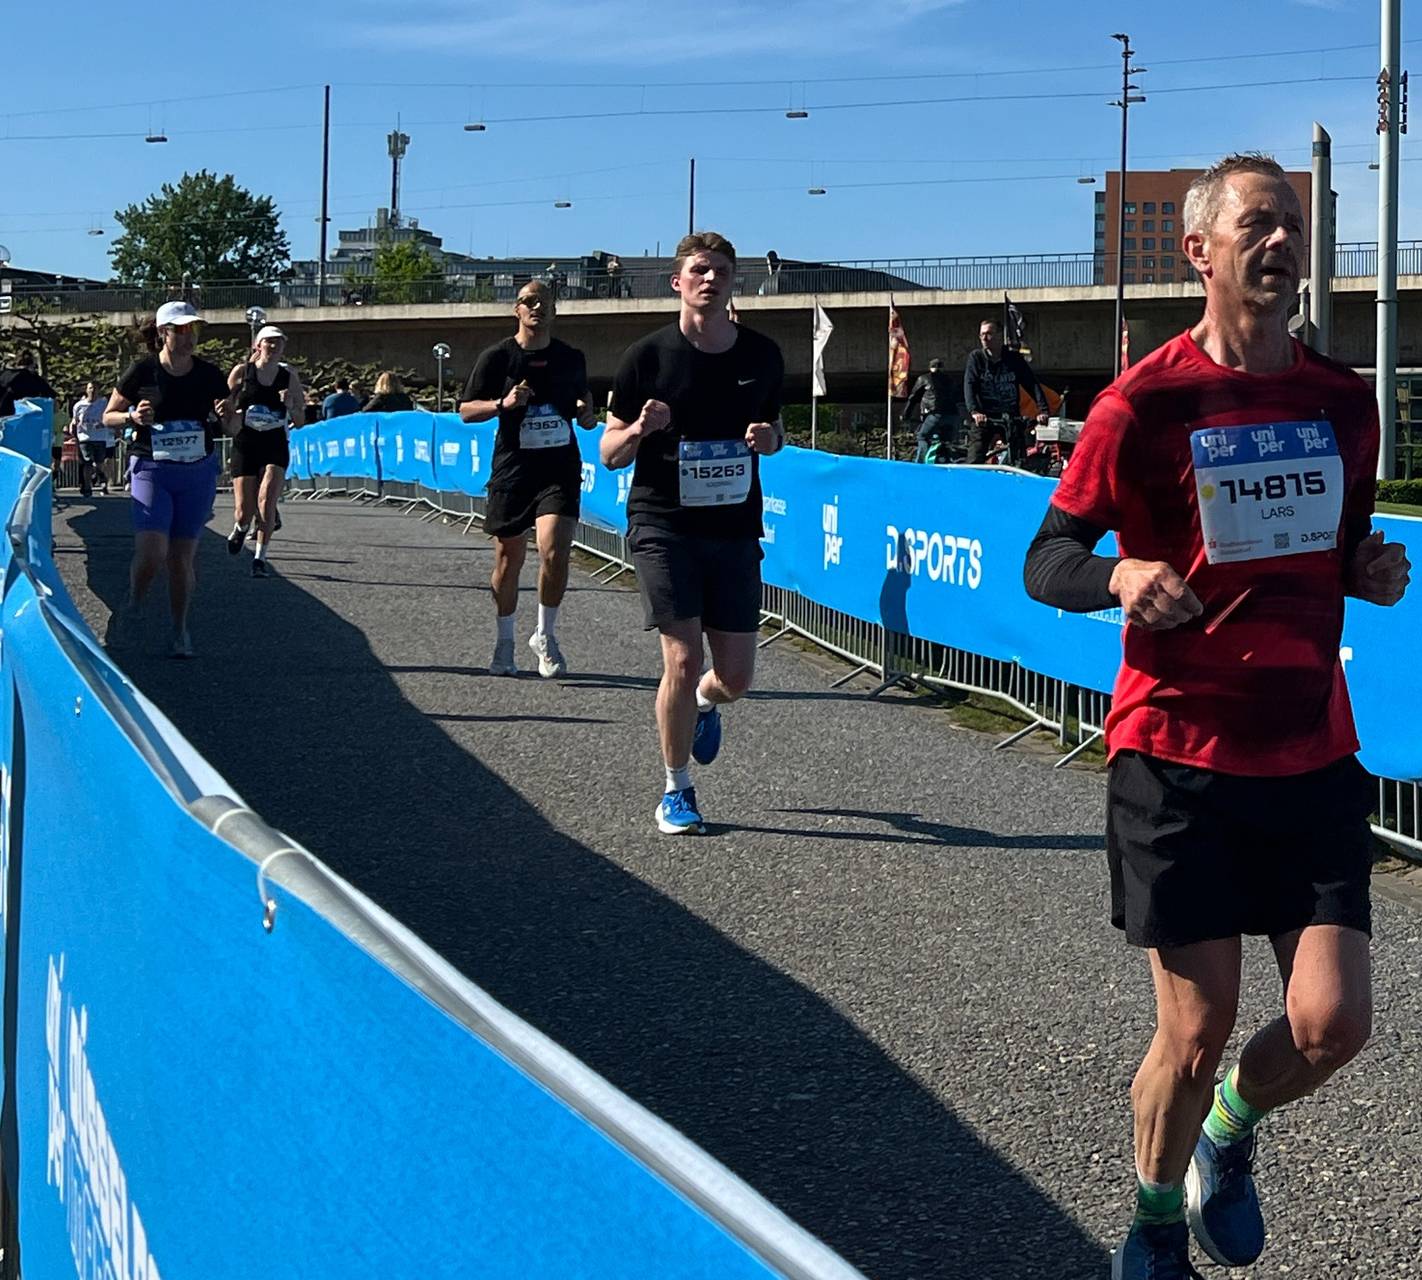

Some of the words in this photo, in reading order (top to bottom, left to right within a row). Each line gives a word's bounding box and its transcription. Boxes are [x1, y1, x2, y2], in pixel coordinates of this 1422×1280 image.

[1200, 429, 1227, 448] uni
[1251, 425, 1276, 442] uni
[1297, 423, 1320, 439] uni
[1208, 444, 1238, 463] per
[1258, 440, 1286, 457] per
[1303, 437, 1330, 454] per
[689, 464, 745, 480] 15263
[1220, 471, 1326, 504] 14815
[822, 494, 838, 534] uni
[1261, 505, 1295, 520] LARS
[824, 533, 843, 570] per
[886, 525, 983, 590] D.SPORTS
